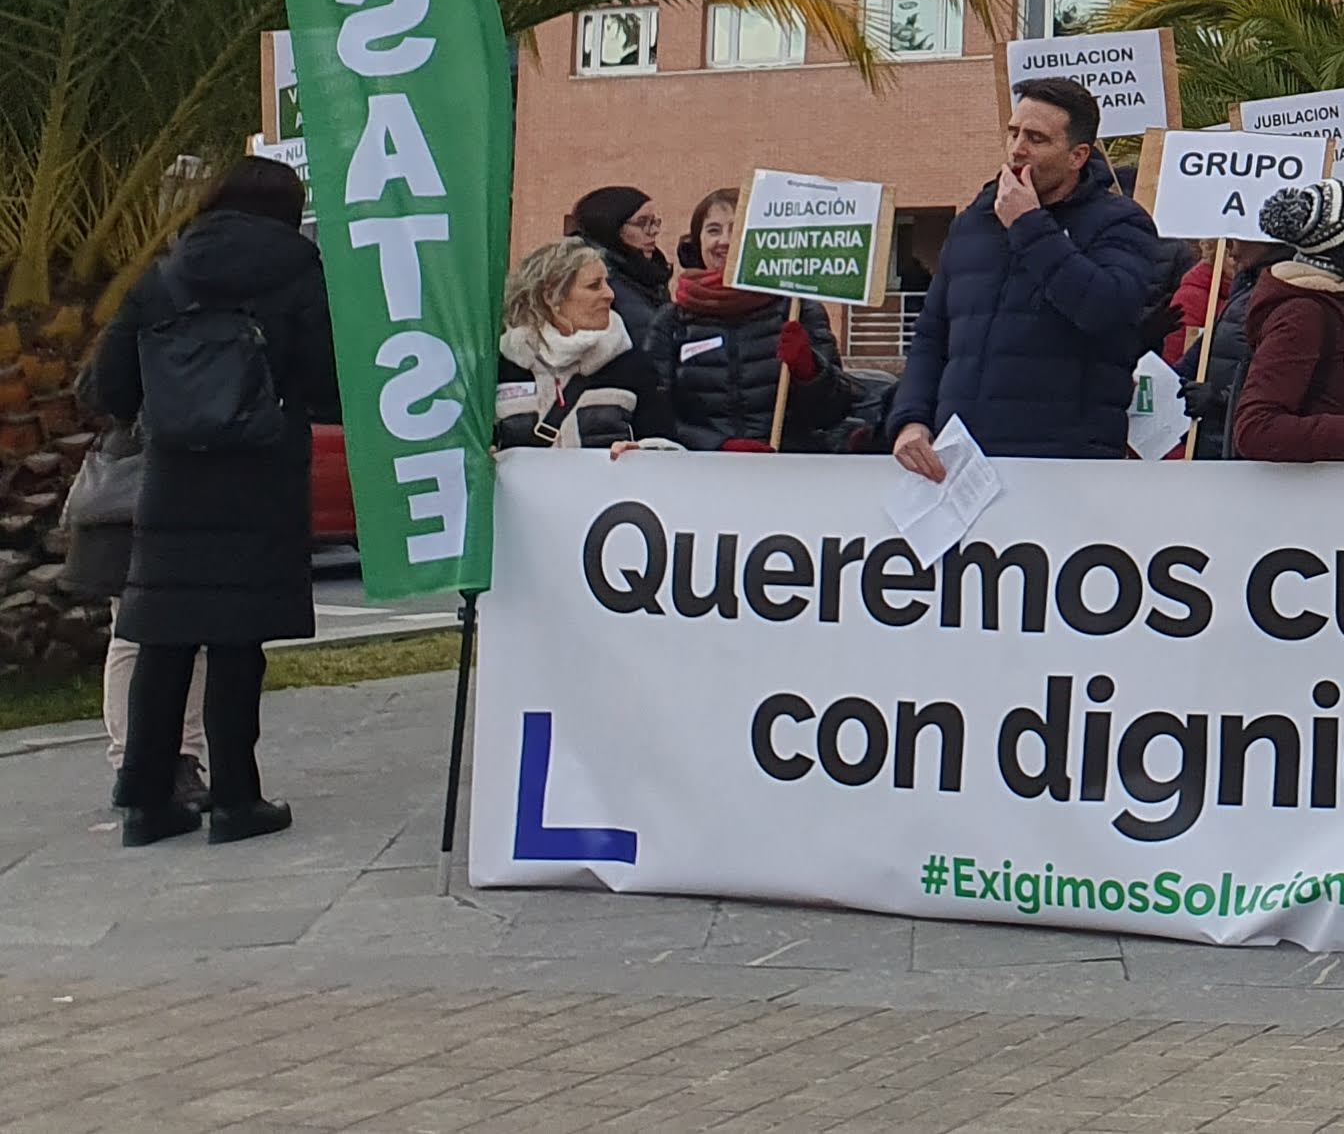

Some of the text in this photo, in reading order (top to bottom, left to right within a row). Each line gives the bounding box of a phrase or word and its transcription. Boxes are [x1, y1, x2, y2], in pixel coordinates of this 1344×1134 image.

[1022, 47, 1134, 71] JUBILACION
[1254, 105, 1340, 130] JUBILACION
[1179, 151, 1303, 180] GRUPO
[763, 197, 856, 218] JUBILACIÓN
[1221, 190, 1247, 217] A
[755, 230, 864, 249] VOLUNTARIA
[755, 258, 860, 276] ANTICIPADA
[583, 500, 1214, 639] Queremos
[751, 692, 966, 793] con
